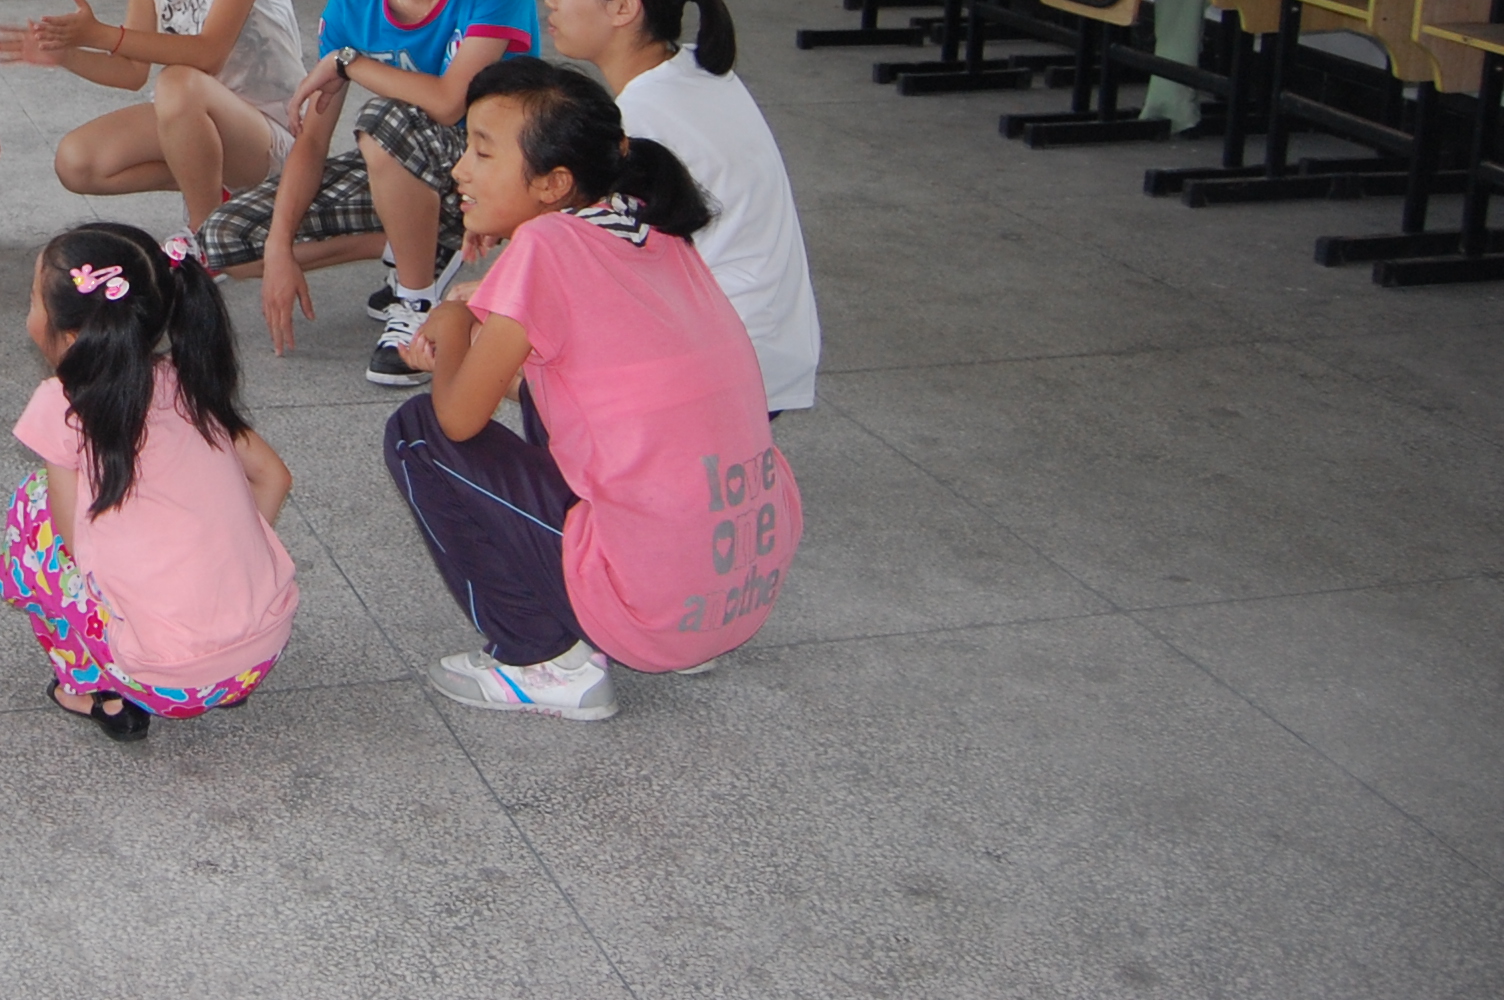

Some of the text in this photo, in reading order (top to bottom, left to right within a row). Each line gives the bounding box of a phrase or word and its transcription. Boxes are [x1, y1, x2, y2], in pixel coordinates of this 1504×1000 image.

[700, 447, 776, 512] love
[712, 502, 776, 576] one
[678, 563, 782, 633] anothe
